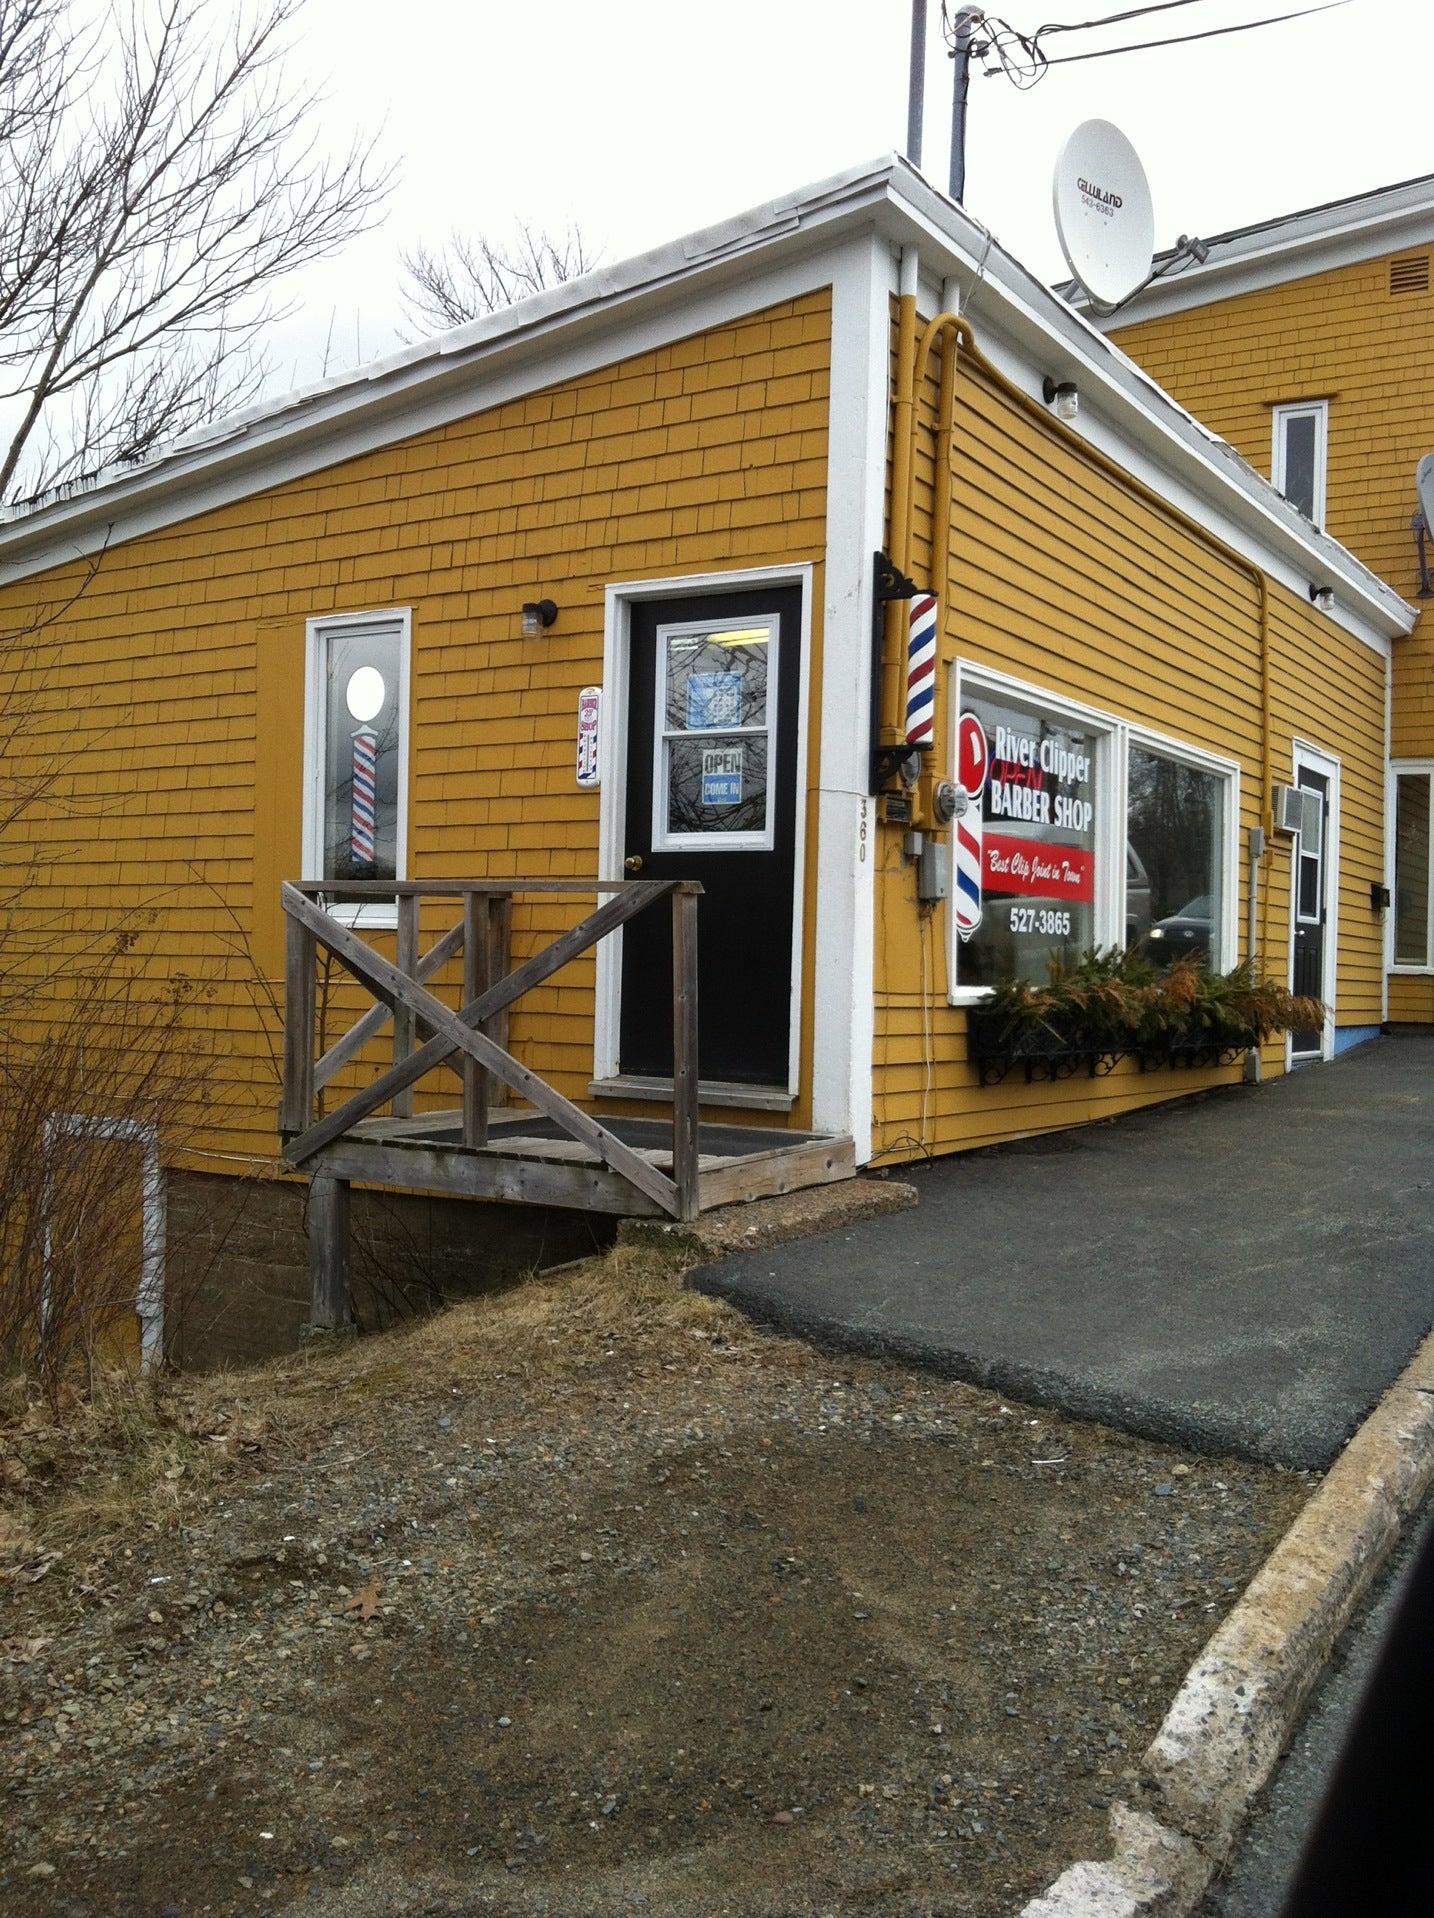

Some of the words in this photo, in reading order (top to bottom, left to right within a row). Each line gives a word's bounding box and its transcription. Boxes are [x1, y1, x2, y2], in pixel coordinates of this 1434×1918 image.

[704, 754, 741, 774] OPEN
[995, 726, 1036, 766] River
[1040, 740, 1090, 784] Clipper
[704, 782, 729, 796] COME
[730, 781, 740, 794] IN
[991, 779, 1050, 824] BARBER
[1054, 795, 1092, 832] SHOP
[1010, 852, 1030, 881] Clip
[1030, 859, 1051, 883] Joint
[1052, 866, 1060, 880] in
[1010, 908, 1070, 936] 527-3865
